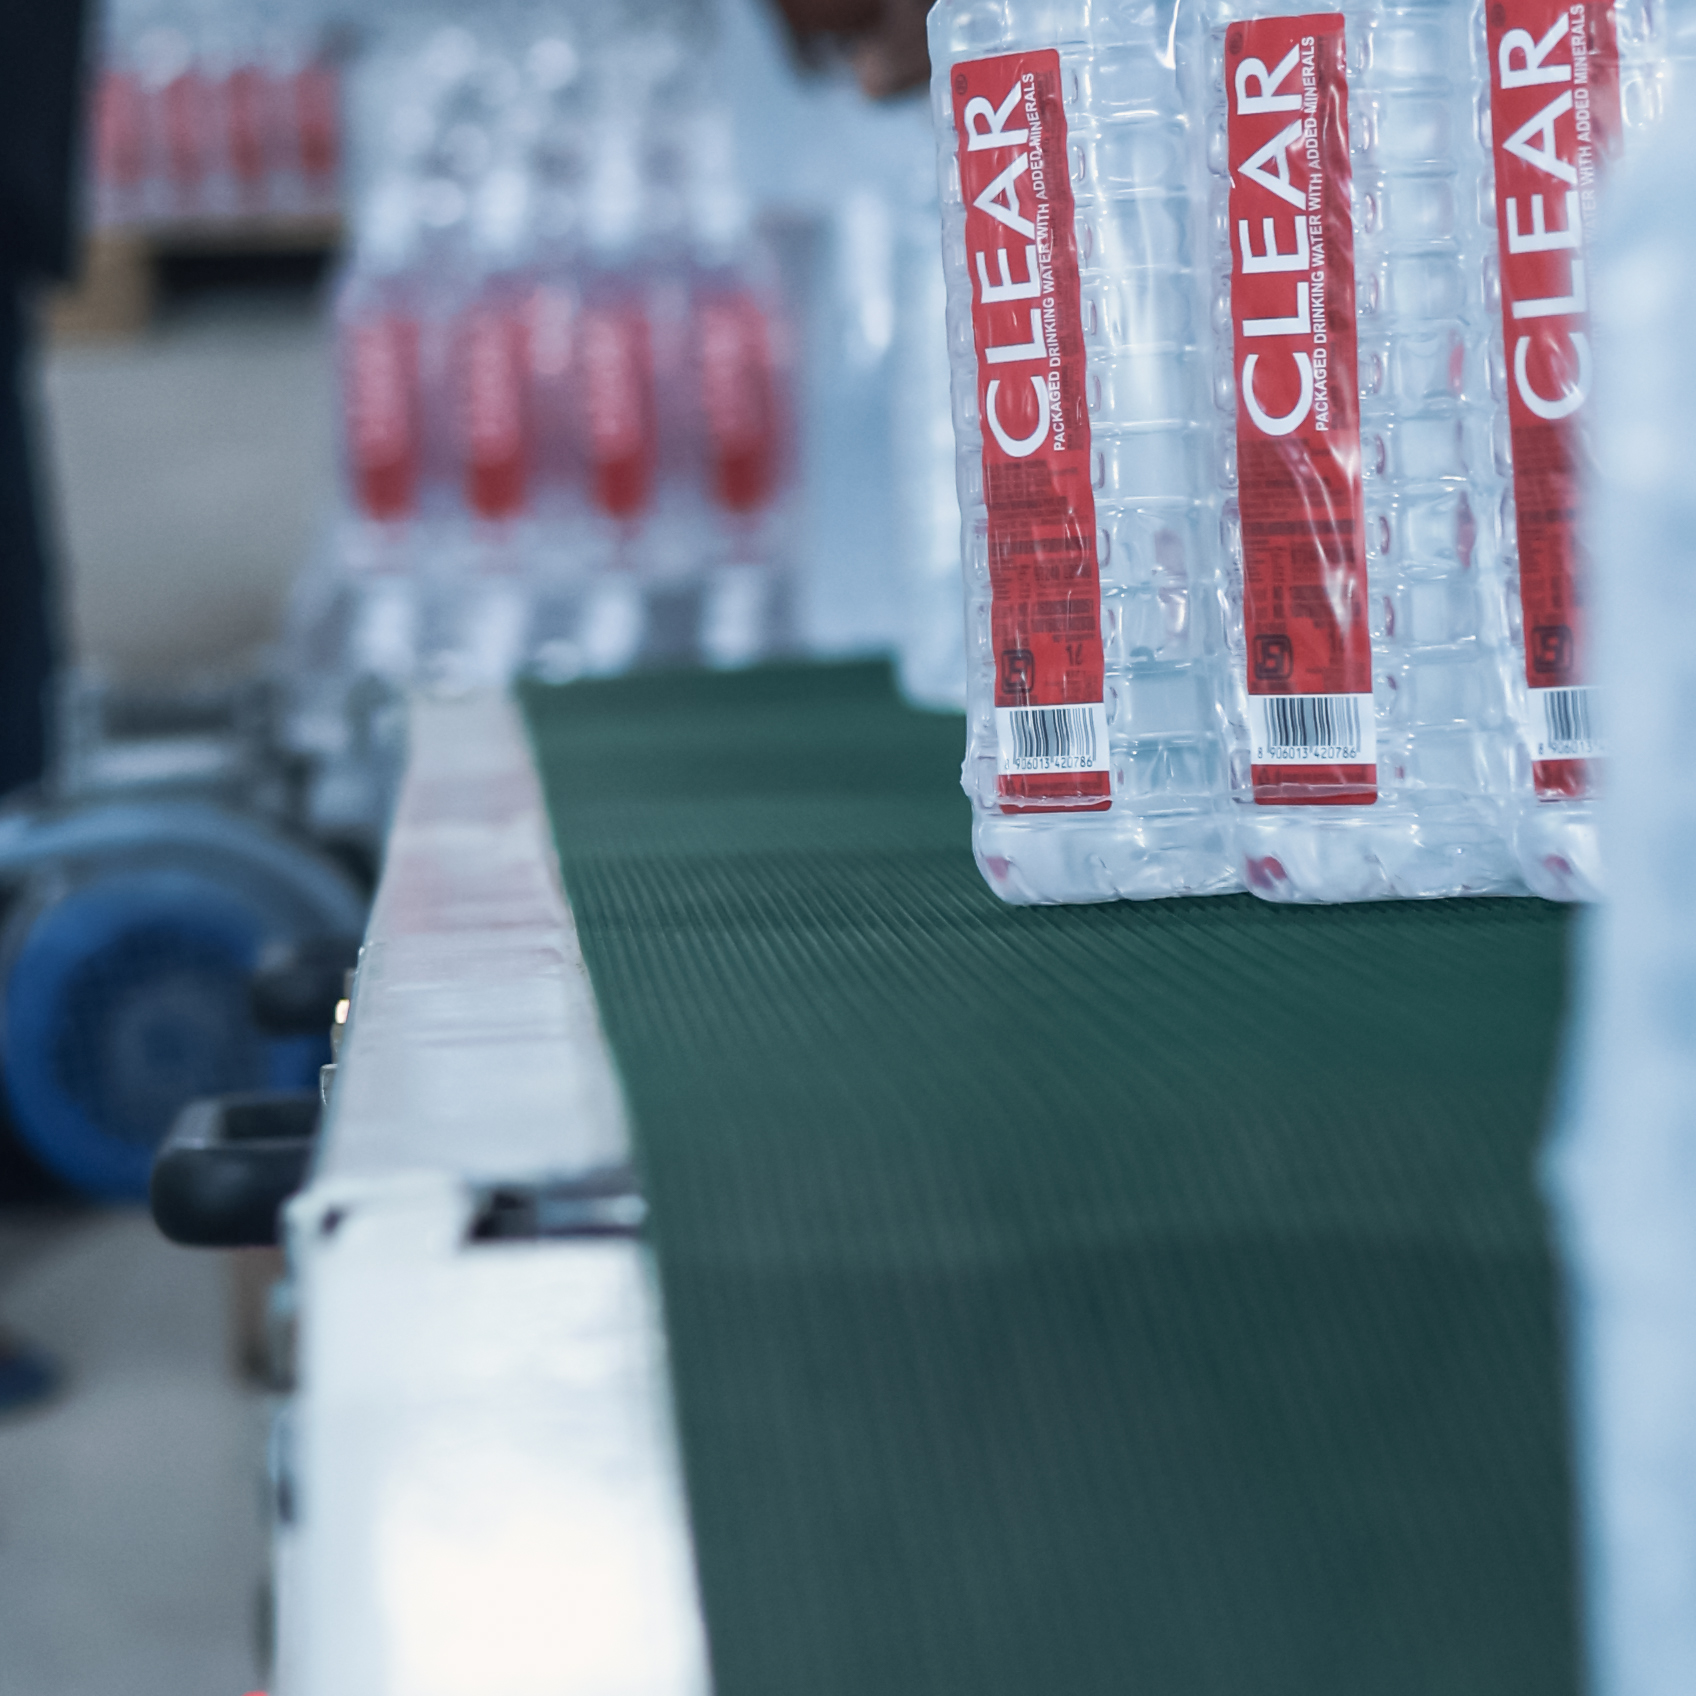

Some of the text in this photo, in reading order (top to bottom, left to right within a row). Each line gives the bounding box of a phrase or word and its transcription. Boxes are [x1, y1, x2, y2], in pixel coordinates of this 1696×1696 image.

[1569, 3, 1588, 85] MINERALS
[1022, 72, 1043, 148] MINERALS
[1574, 87, 1590, 142] ADDED
[1030, 150, 1048, 200] ADDED
[1578, 146, 1594, 185] WITH
[1036, 204, 1050, 242] WITH
[1235, 43, 1314, 436] CLEAR
[1302, 35, 1329, 431] PACKAGED DRINKING WATER WITH ADDED MINERALS
[1498, 11, 1592, 420] CLEAR
[964, 80, 1050, 457] CLEAR
[1038, 242, 1055, 294] WATER
[1042, 297, 1061, 367] DRINKING
[1049, 369, 1065, 451] PACKAGED
[1015, 757, 1050, 770] 906013
[1055, 755, 1093, 769] 420786
[1257, 746, 1357, 759] 8 906013 420786
